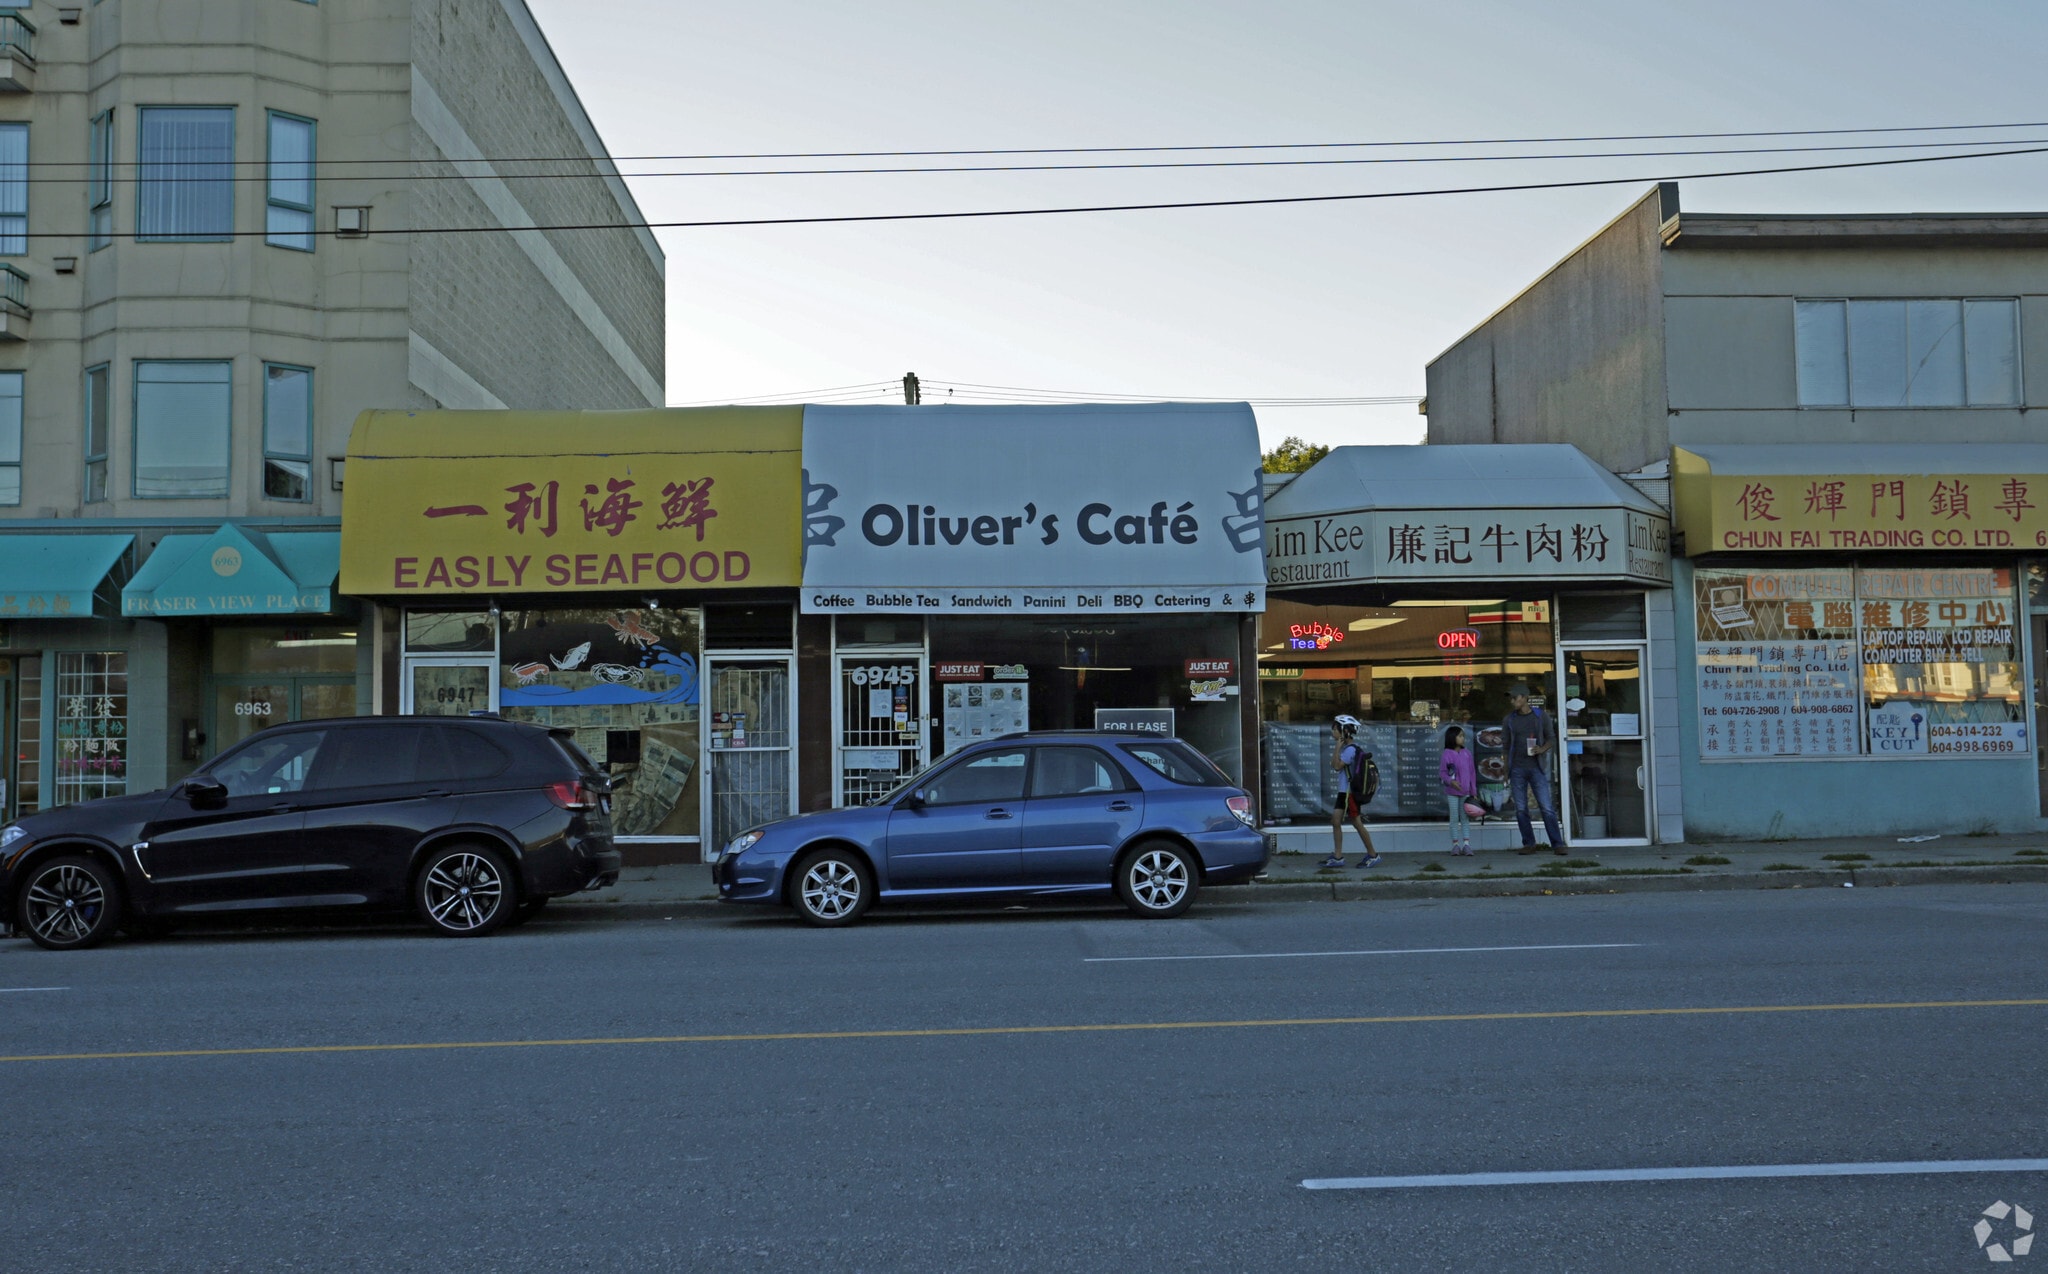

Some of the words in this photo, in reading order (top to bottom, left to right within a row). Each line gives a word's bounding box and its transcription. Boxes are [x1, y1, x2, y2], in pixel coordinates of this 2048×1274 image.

[424, 476, 718, 541] 一利海鮮
[1736, 479, 2036, 522] 俊輝門鎖專
[1076, 501, 1199, 545] Café
[1314, 519, 1363, 553] Kee
[1627, 513, 1647, 550] Lim
[1648, 518, 1666, 553] Kee
[1724, 531, 1782, 548] CHUN
[1791, 531, 1820, 547] FAI
[1830, 530, 1924, 547] TRADING
[1932, 529, 1966, 547] CO.
[1974, 530, 2014, 546] LTD.
[1387, 523, 1609, 564] 廉記牛肉粉
[214, 556, 239, 567] 6963
[394, 555, 532, 588] EASLY
[546, 550, 751, 586] SEAFOOD
[1628, 550, 1665, 578] Restaurant
[1266, 559, 1350, 583] estaurant
[1751, 575, 1851, 598] COMPUTER
[1860, 574, 1926, 596] REPAIR
[1930, 573, 1998, 595] CENTRE
[127, 596, 197, 612] FRASER
[208, 595, 256, 610] VIEW
[266, 594, 325, 609] PLACE
[813, 594, 855, 607] Coffee
[866, 594, 912, 607] Bubble
[916, 595, 940, 607] Tea
[952, 594, 1012, 607] Sandwich
[1024, 595, 1066, 608] Panini
[1078, 594, 1103, 607] Deli
[1114, 594, 1143, 608] BBQ
[1155, 594, 1211, 609] Catering
[1222, 594, 1232, 605] &
[1785, 600, 2006, 629] 電腦維修中心
[1290, 622, 1344, 643] Bubble
[1438, 633, 1476, 648] OPEN
[1862, 630, 1903, 646] LAPTOP
[1906, 630, 1944, 645] REPAIR
[1951, 630, 1972, 645] LCD
[1975, 629, 2012, 645] REPAIR
[1290, 638, 1315, 649] Tea
[1864, 648, 1922, 663] COMPUTER
[1925, 648, 1946, 663] BUY
[1949, 648, 1958, 662] &
[1960, 648, 1984, 662] SELL
[939, 665, 961, 674] JUST
[963, 664, 980, 673] EAT
[1189, 662, 1211, 671] JUST
[1212, 662, 1230, 671] EAT
[1705, 665, 1732, 674] Chun
[1736, 665, 1753, 674] Fai
[1758, 664, 1801, 675] Trading
[1805, 663, 1824, 672] Co.
[1828, 663, 1850, 672] Ltd.
[852, 666, 915, 685] 6945
[438, 687, 475, 704] 6947
[234, 702, 272, 716] 6963
[1703, 706, 1717, 716] Tel:
[1721, 706, 1780, 716] 604-726-2908
[1783, 705, 1787, 716] /
[1790, 704, 1853, 715] 604-908-6862
[1104, 722, 1127, 731] FOR
[1130, 722, 1167, 732] LEASE
[1871, 727, 1909, 739] KEY
[1931, 725, 2004, 737] 604-614-232
[1881, 738, 1915, 751] CUT
[1932, 740, 2015, 752] 604-998-6969
